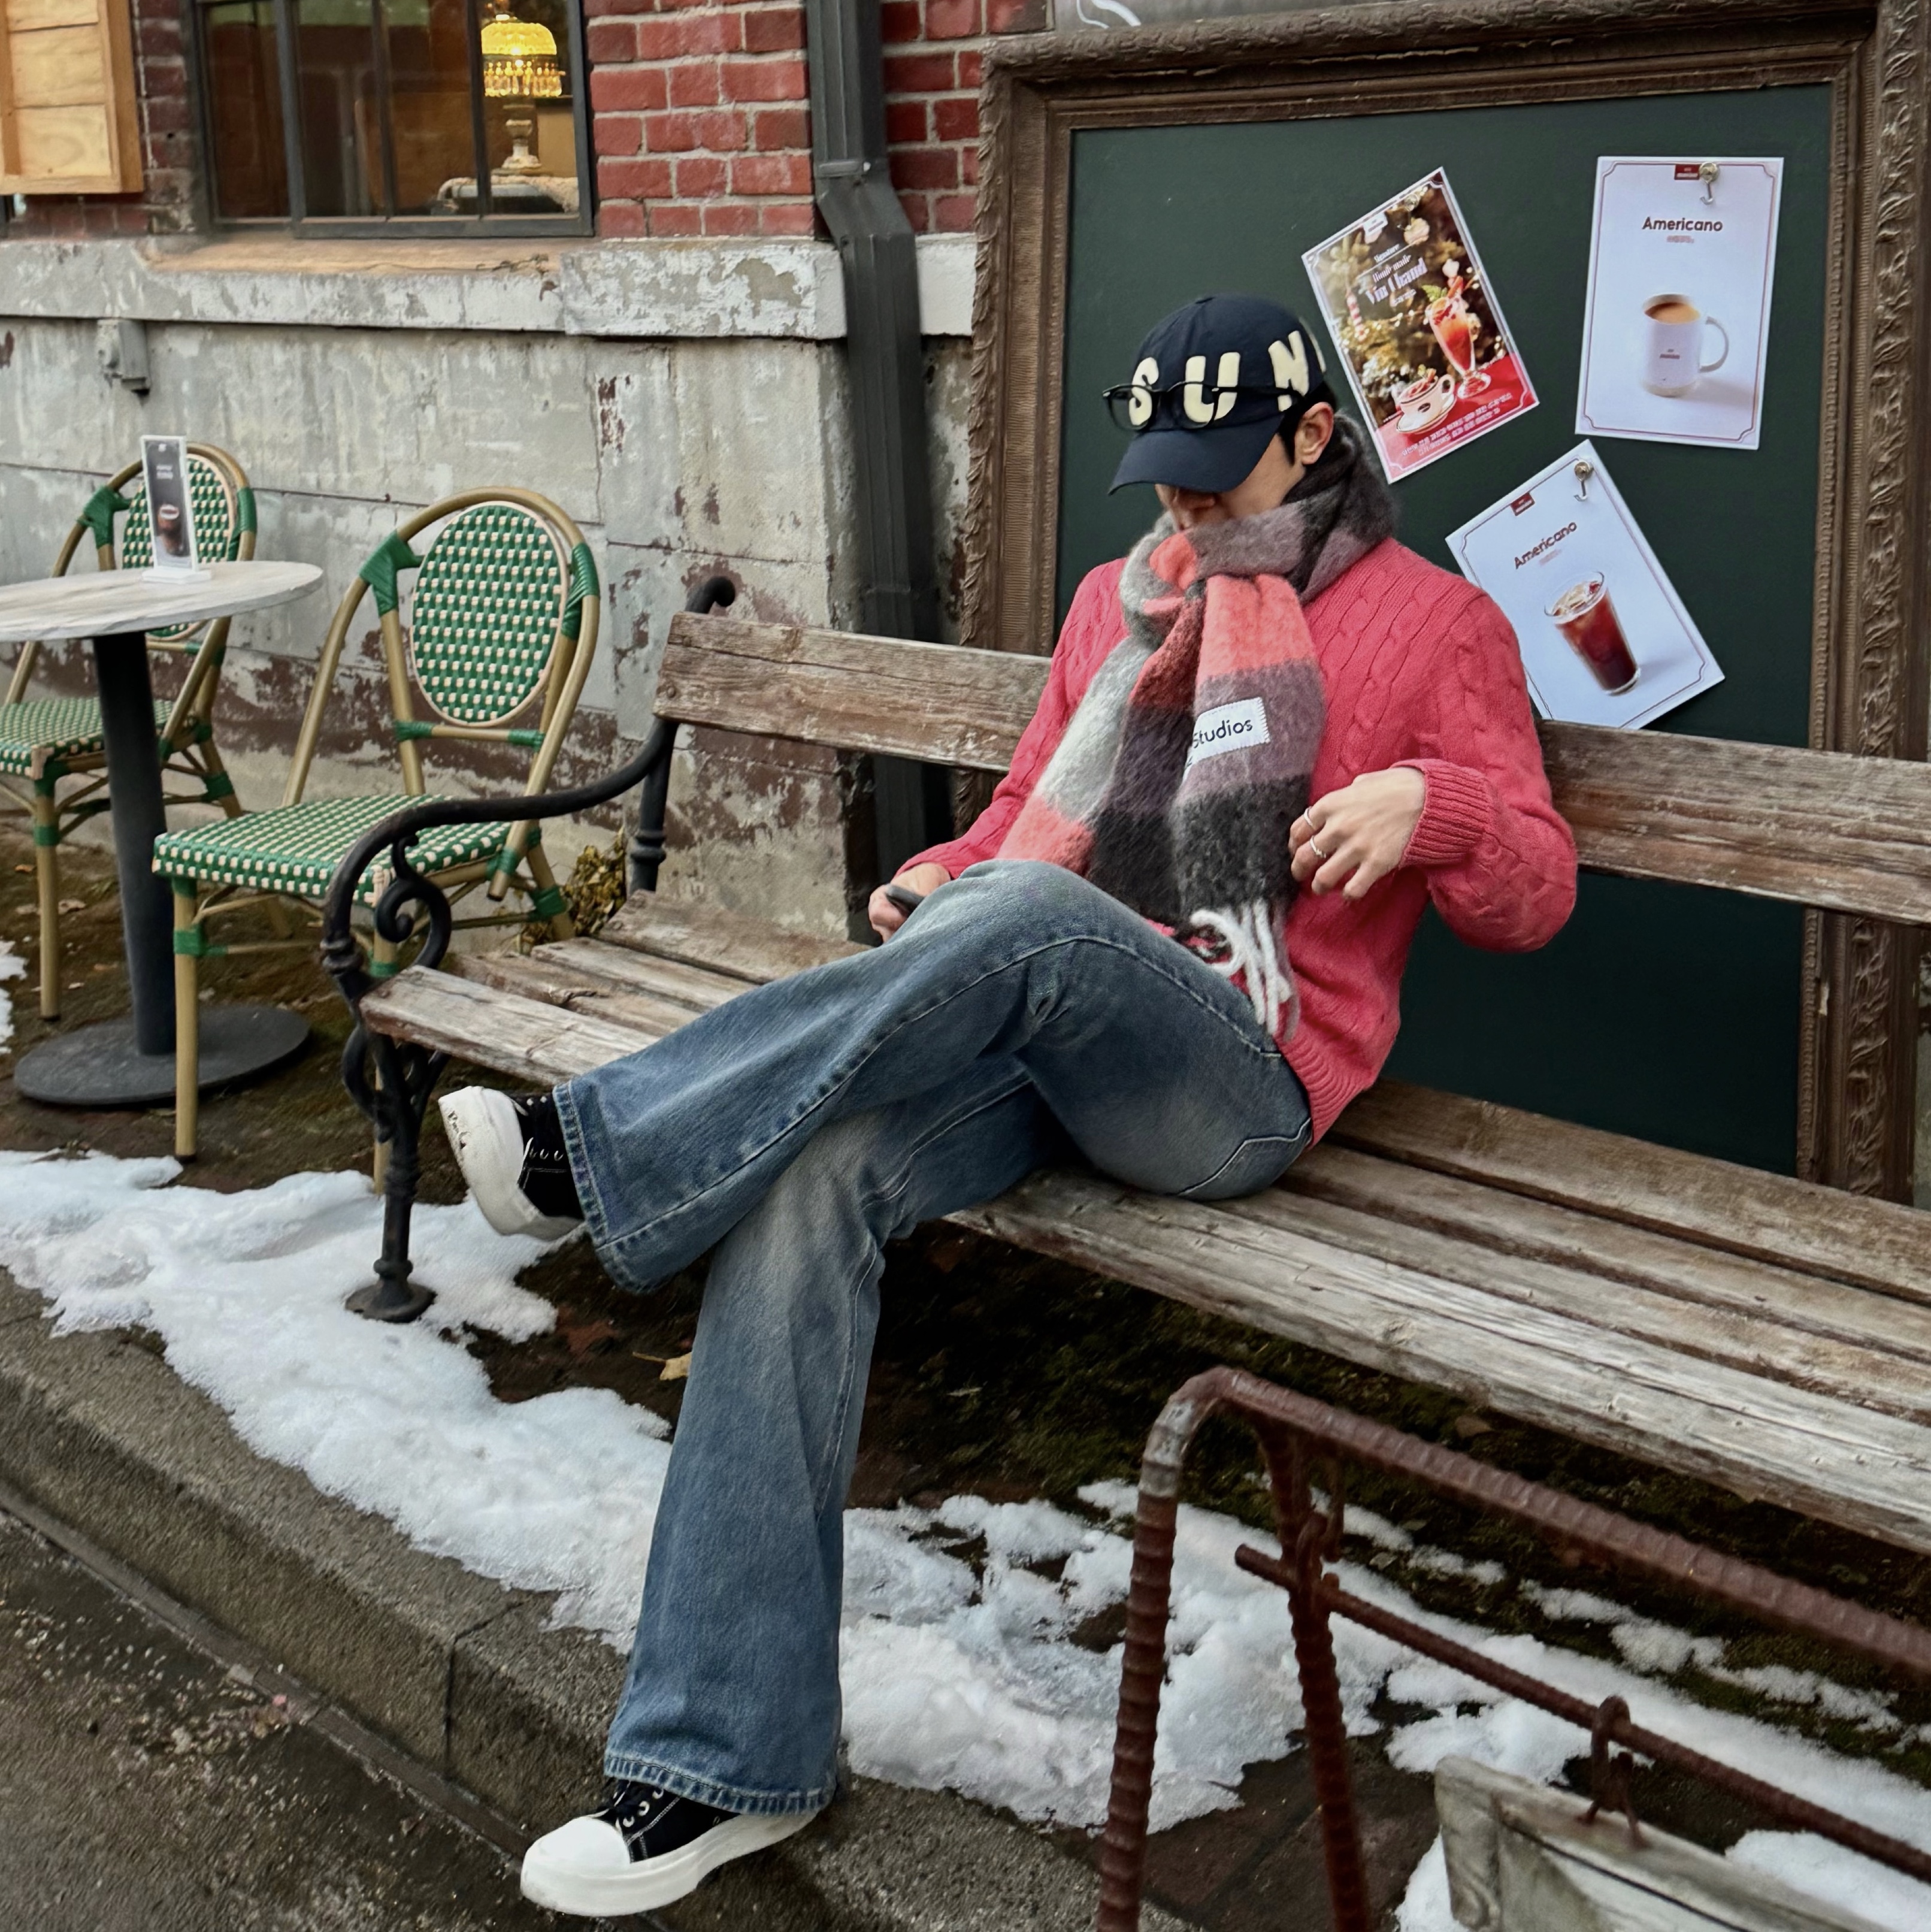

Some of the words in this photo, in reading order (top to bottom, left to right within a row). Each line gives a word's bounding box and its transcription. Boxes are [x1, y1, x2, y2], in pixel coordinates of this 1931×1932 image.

[1642, 216, 1723, 232] Americano
[1128, 319, 1326, 426] SUN
[1514, 522, 1577, 570] Americano
